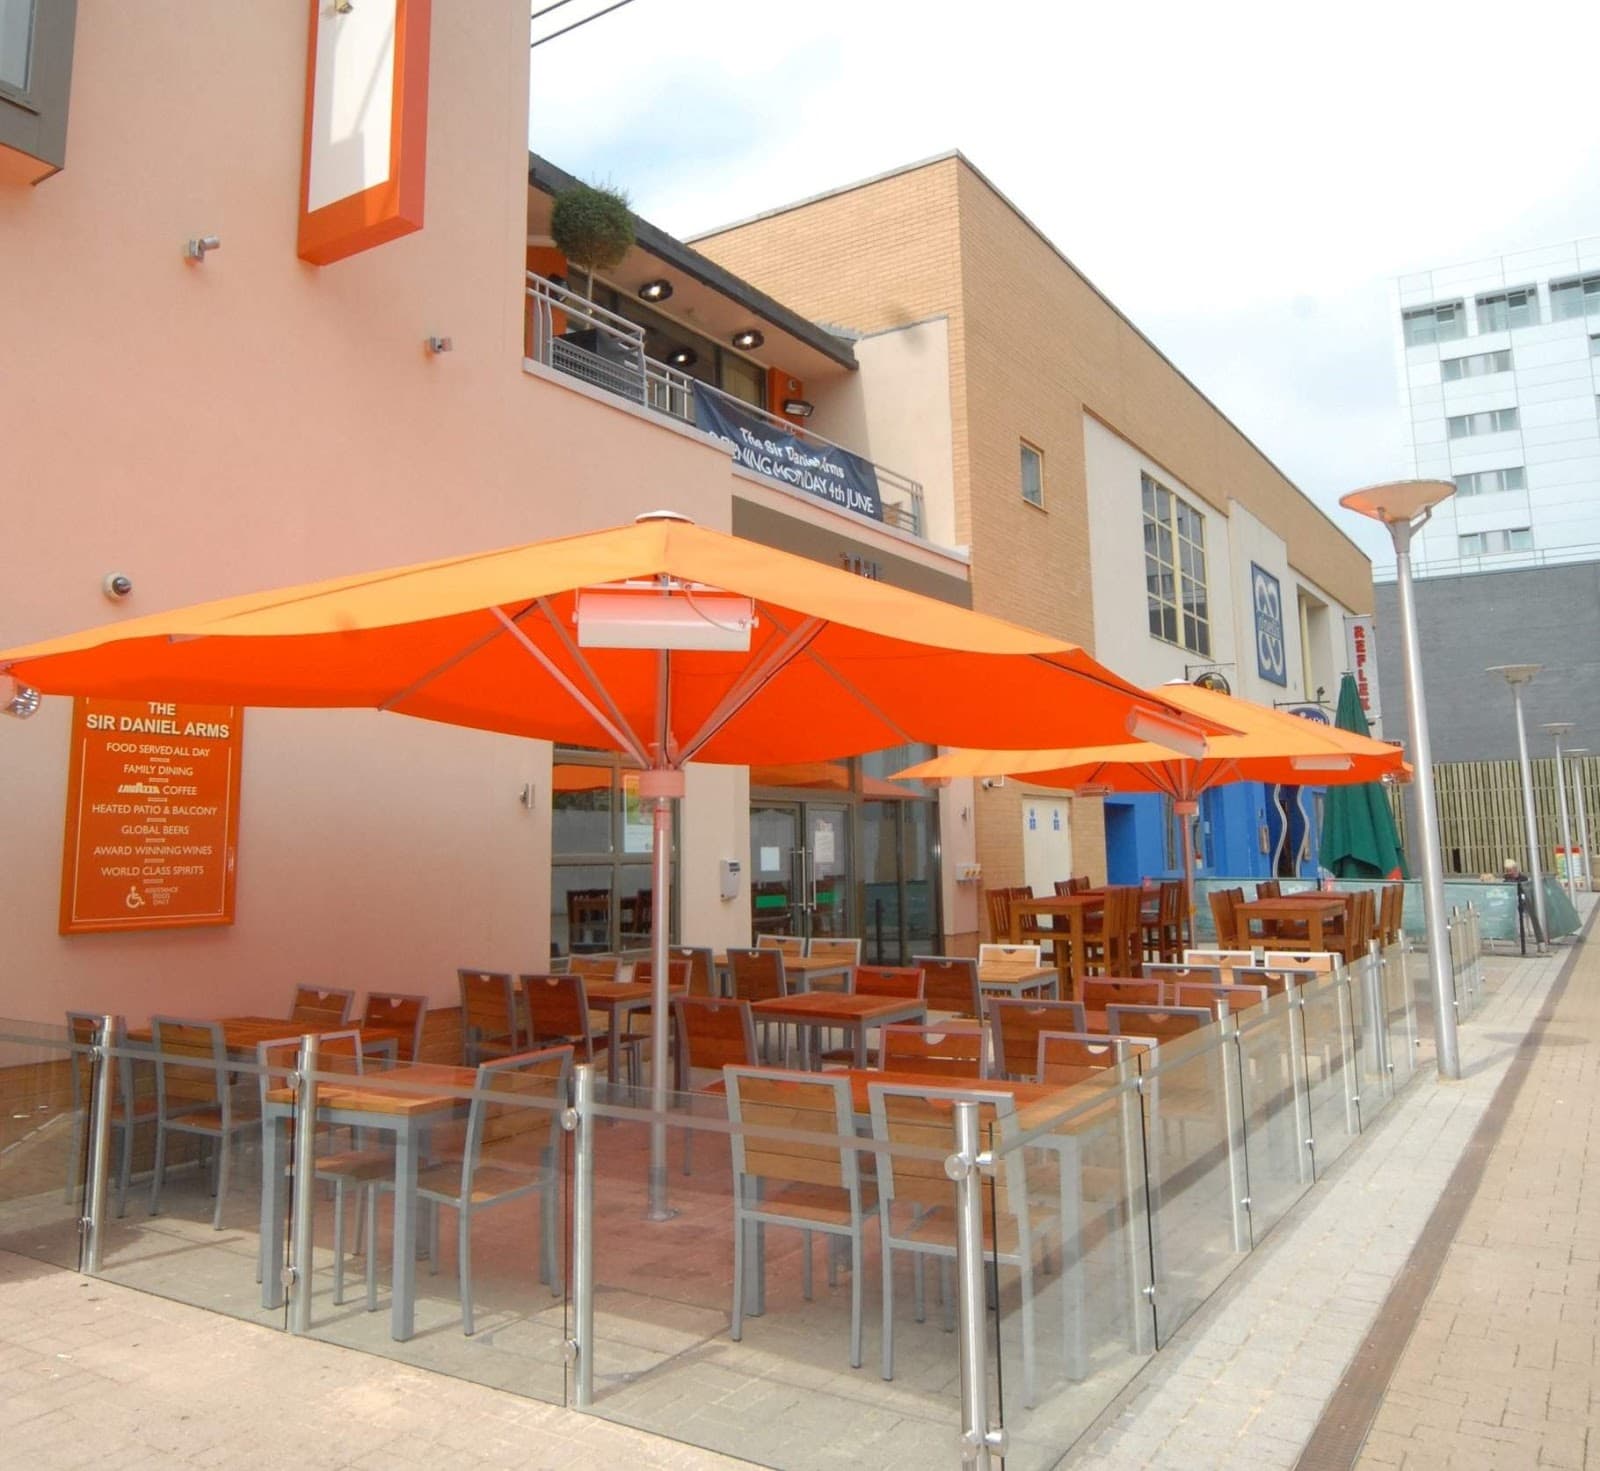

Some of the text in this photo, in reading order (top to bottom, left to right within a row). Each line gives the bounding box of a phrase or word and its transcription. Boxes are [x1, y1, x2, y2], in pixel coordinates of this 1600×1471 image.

[740, 427, 764, 450] The
[764, 440, 784, 458] Sir
[819, 457, 845, 479] Arms
[709, 431, 875, 513] NING MONDAY 4th JUNE
[148, 702, 176, 716] THE
[87, 714, 229, 738] SIR DANIEL ARMS
[106, 742, 211, 757] FOOD SERVED ALL DAY
[123, 764, 193, 776] FAMILY DINING
[162, 785, 198, 796] COFFEE
[92, 804, 131, 814] HEATED
[133, 805, 161, 815] PATIO
[172, 806, 217, 816] BALCONY
[121, 825, 189, 835] GLOBAL BEERS
[94, 846, 213, 855] AWARD WINNING WINES
[101, 865, 204, 876] WORLD CLASS SPIRITS
